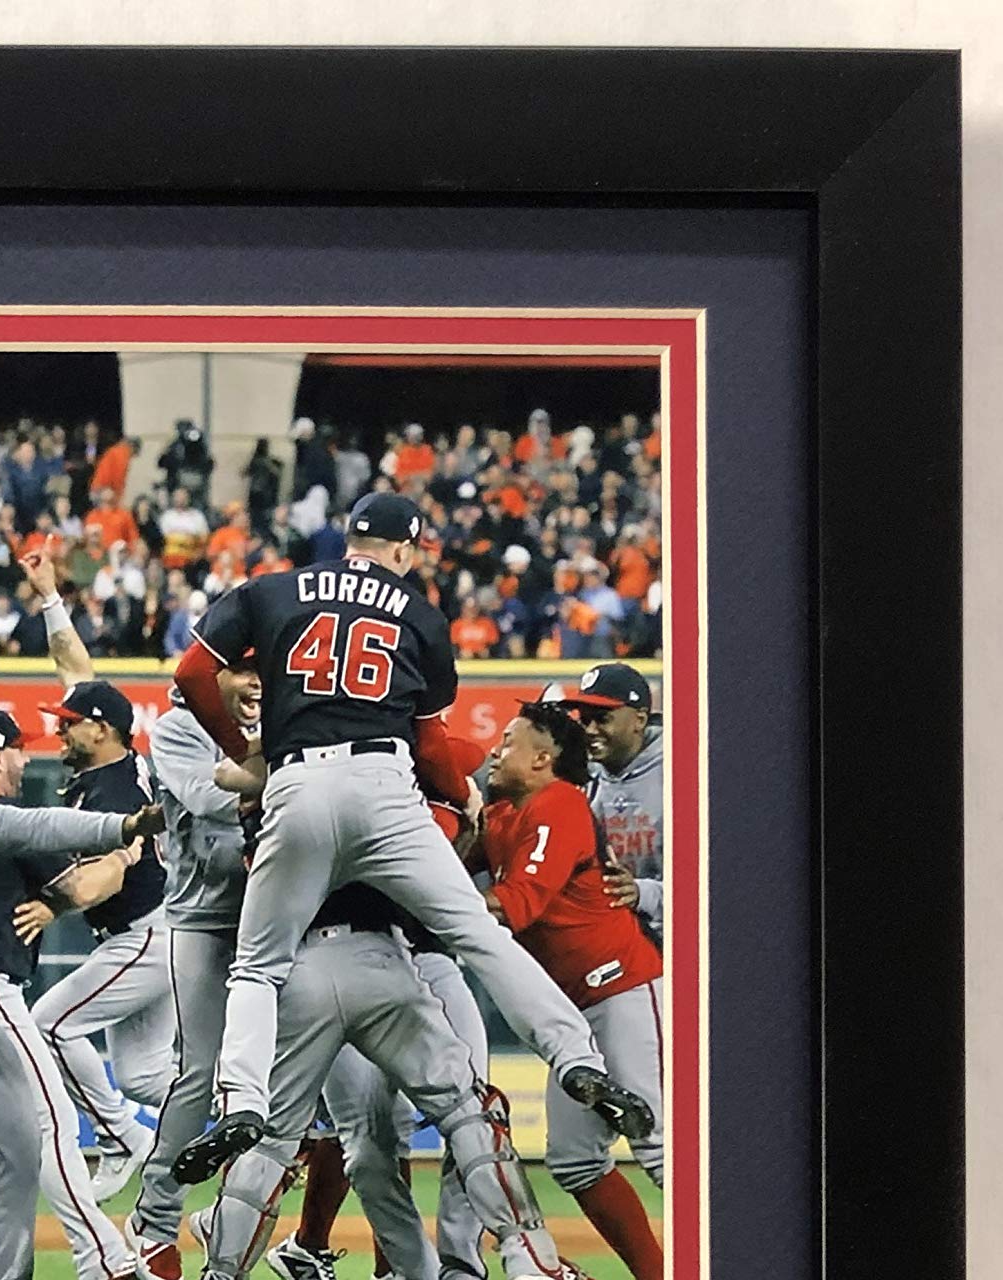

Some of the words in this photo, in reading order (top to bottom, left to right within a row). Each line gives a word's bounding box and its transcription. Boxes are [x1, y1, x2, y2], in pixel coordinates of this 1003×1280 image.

[297, 571, 410, 617] CORBIN
[286, 611, 401, 702] 46
[530, 825, 551, 863] 1
